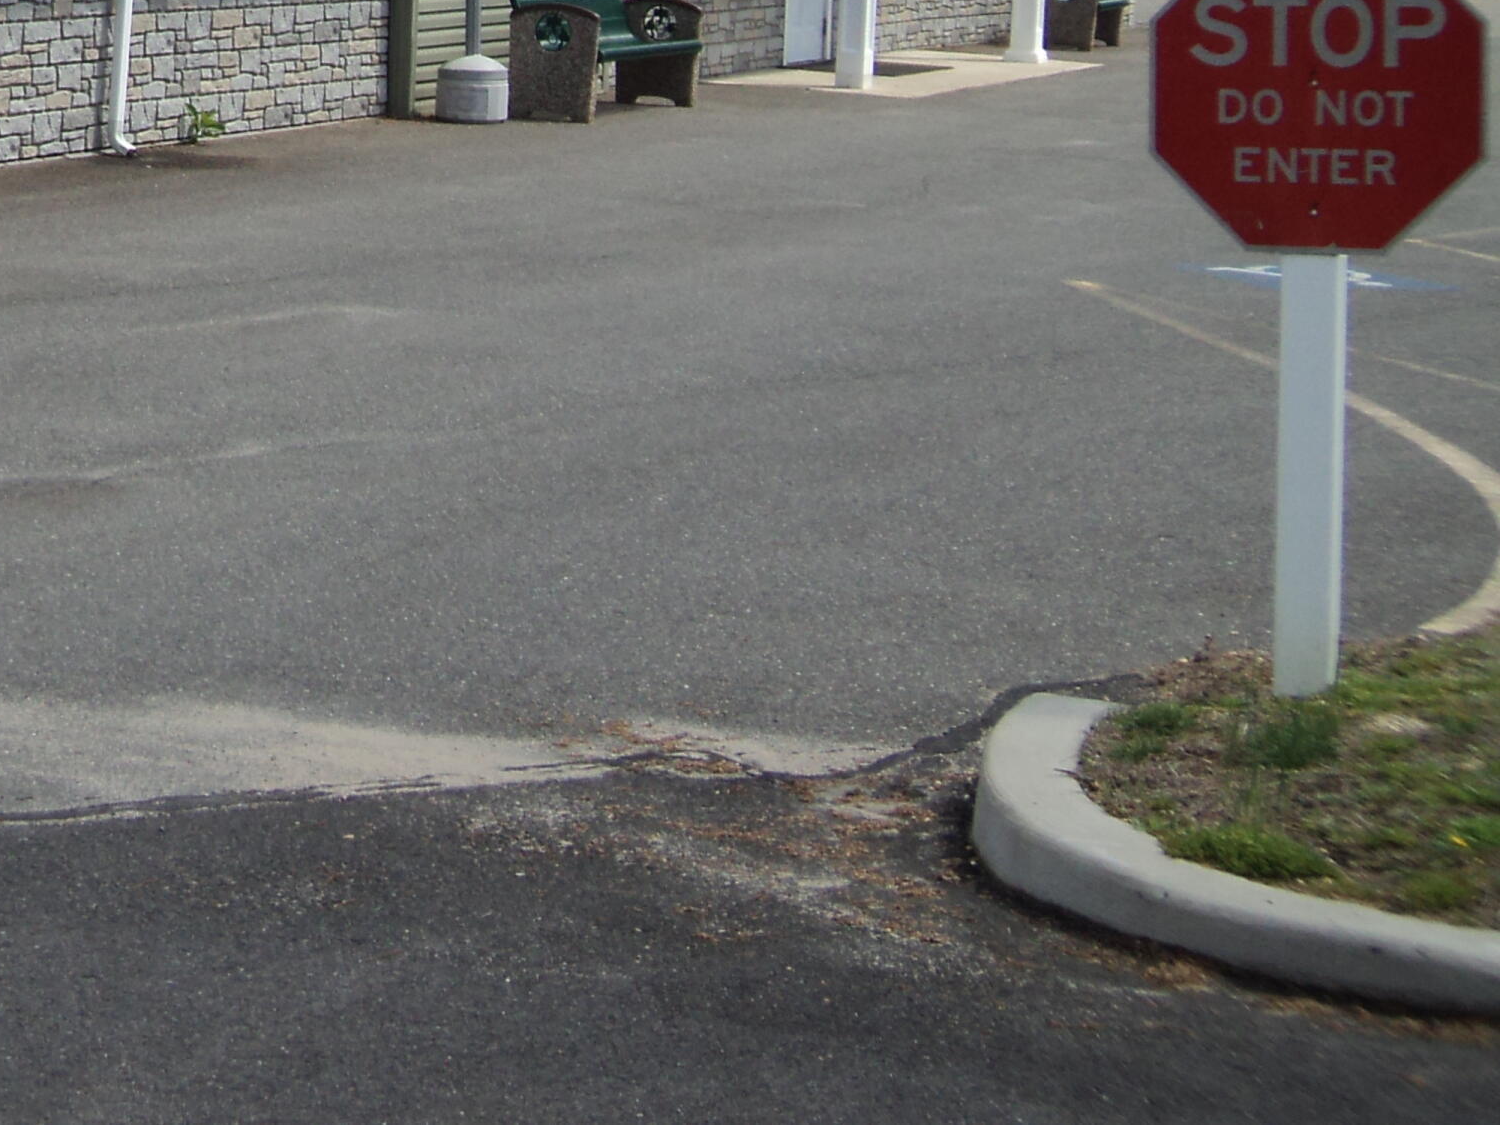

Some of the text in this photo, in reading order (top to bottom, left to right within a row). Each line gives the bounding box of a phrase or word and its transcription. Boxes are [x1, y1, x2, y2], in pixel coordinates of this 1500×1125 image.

[1218, 88, 1415, 126] DO NOT
[1233, 146, 1397, 185] ENTER
